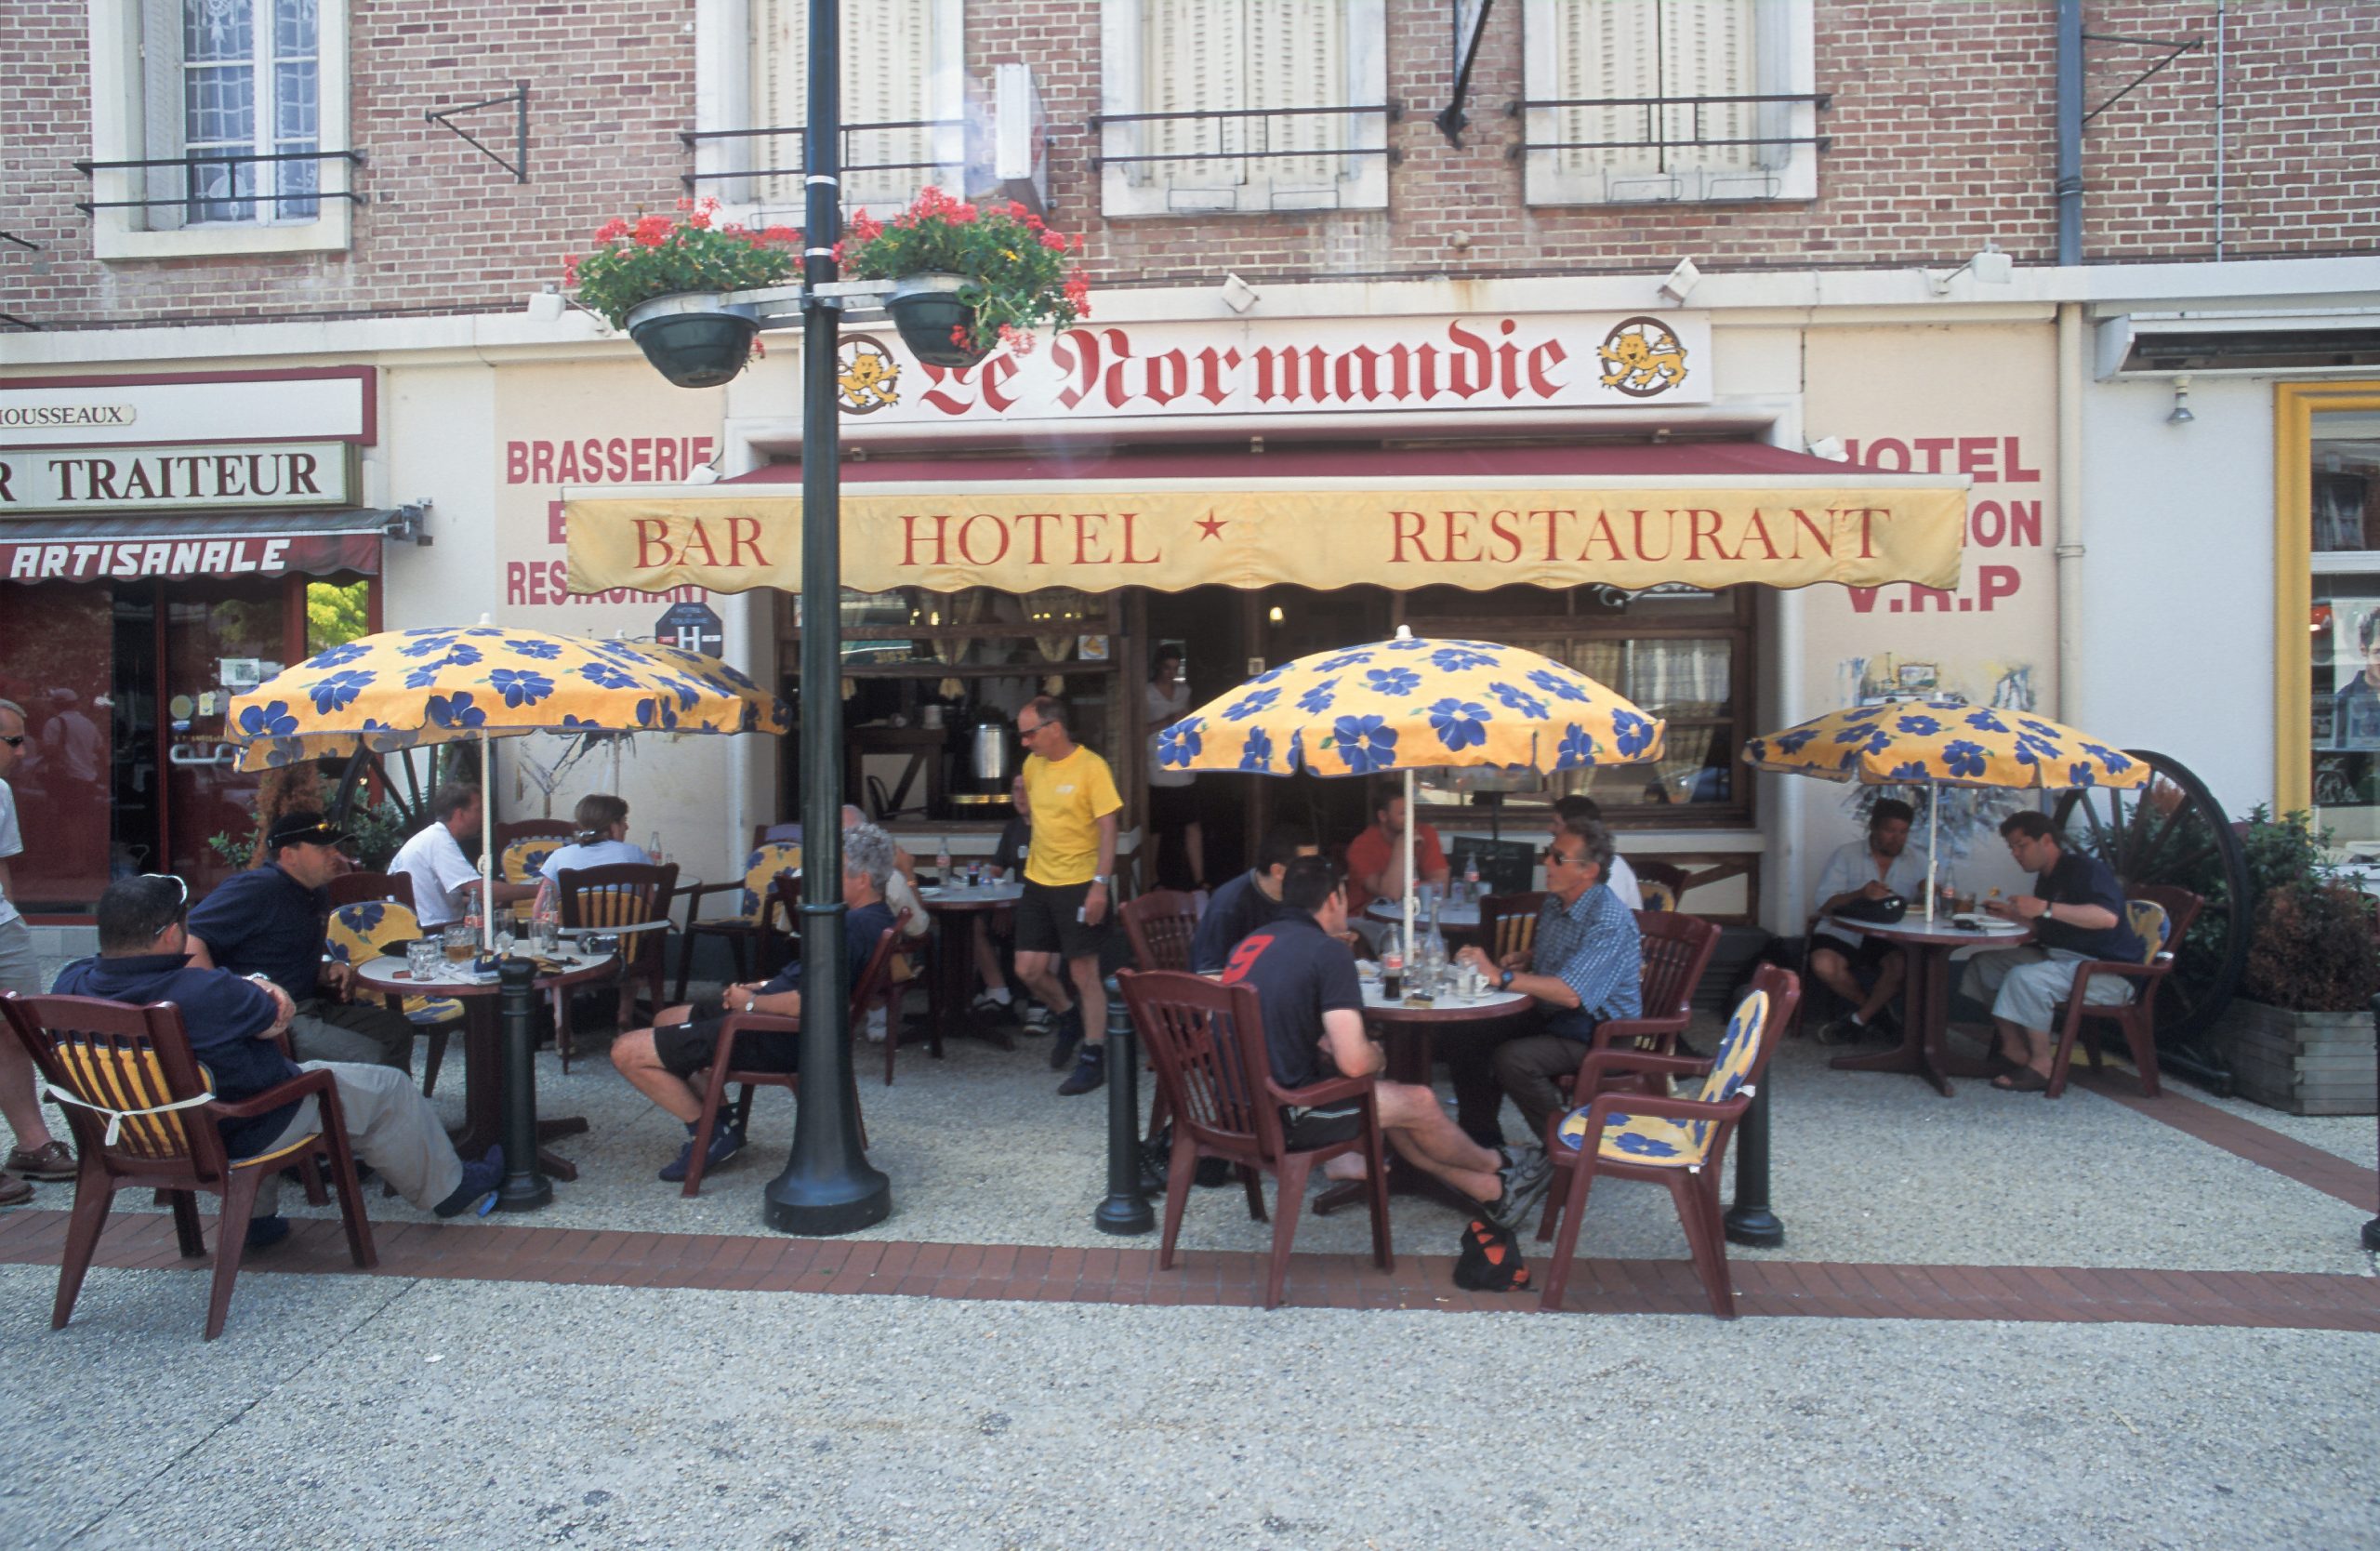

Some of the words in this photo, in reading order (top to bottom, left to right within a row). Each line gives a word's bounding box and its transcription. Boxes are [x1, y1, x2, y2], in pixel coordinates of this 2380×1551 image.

[1051, 318, 1570, 411] Normandie
[48, 453, 321, 501] TRAITEUR
[10, 538, 291, 578] ARTISANALE
[631, 517, 773, 569] BAR
[898, 512, 1161, 566] HOTEL
[1388, 508, 1891, 563] RESTAURANT
[1222, 935, 1275, 985] 9
